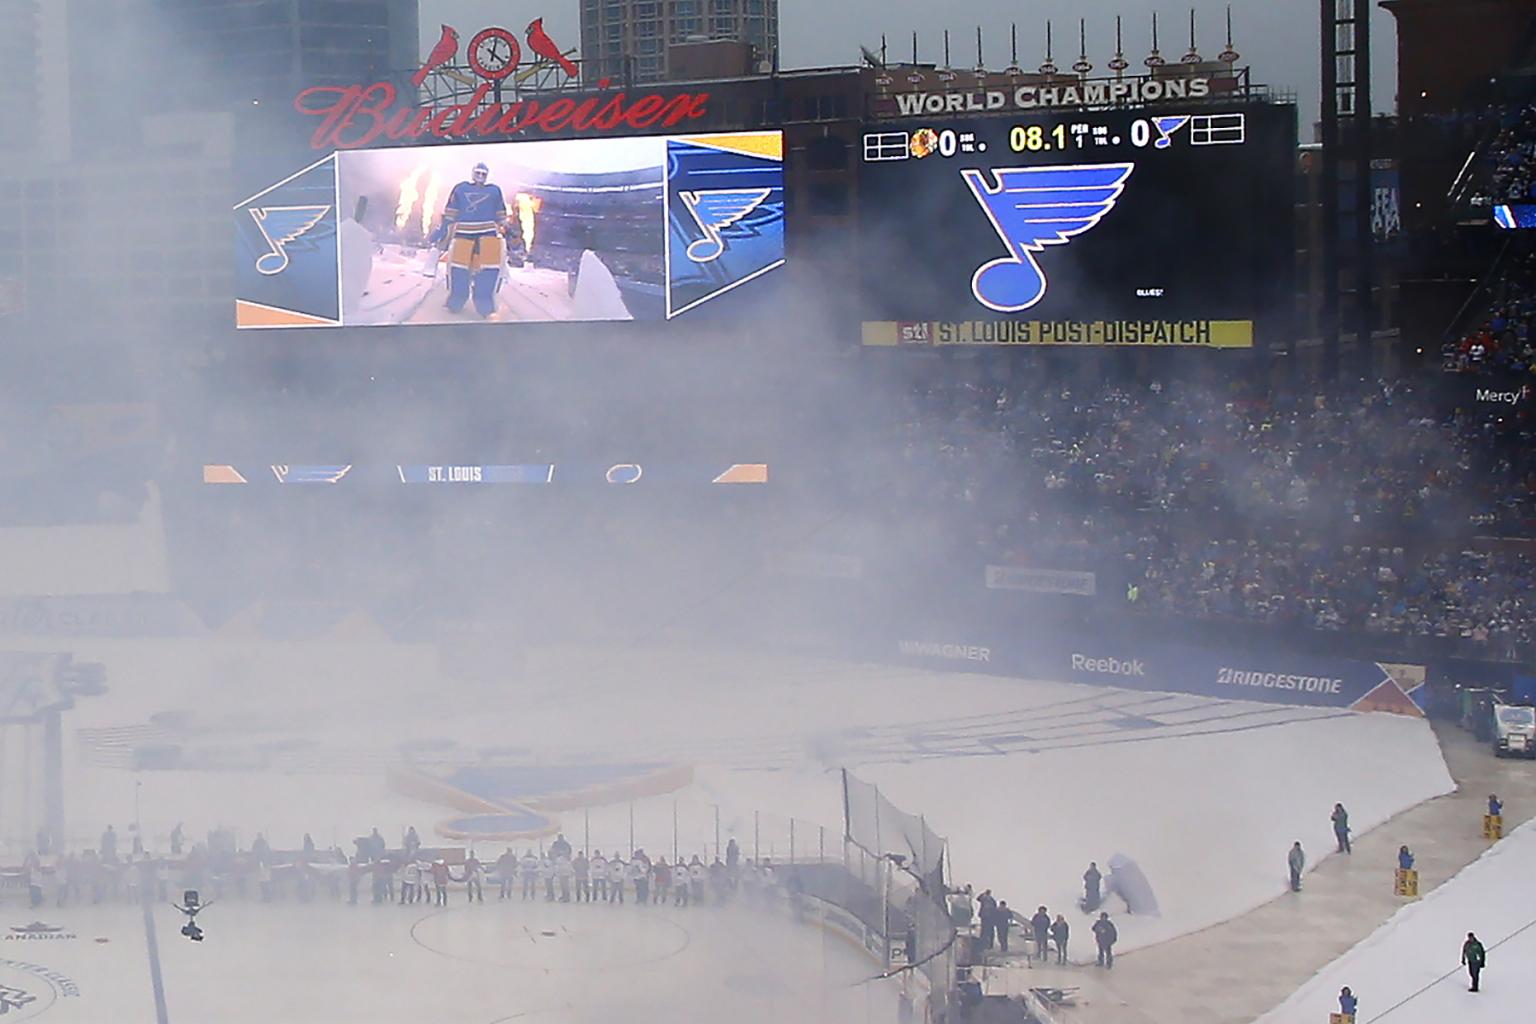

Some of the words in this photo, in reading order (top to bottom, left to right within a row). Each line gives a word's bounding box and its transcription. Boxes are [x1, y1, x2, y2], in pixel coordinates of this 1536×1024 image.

[895, 91, 1005, 116] WORLD
[1013, 77, 1210, 109] CHAMPIONS
[294, 79, 710, 149] Budweiser
[938, 129, 956, 157] 0
[1010, 124, 1066, 153] 08.1
[1130, 119, 1150, 147] 0
[938, 321, 967, 345] ST.
[971, 321, 1031, 344] LOUIS
[1038, 320, 1211, 345] POST-DISPATCH
[1476, 388, 1521, 405] Mercy
[427, 465, 447, 482] ST.
[448, 465, 482, 482] LOUIS
[1070, 652, 1145, 677] Reebok
[1216, 667, 1342, 694] BRIDGESTONE
